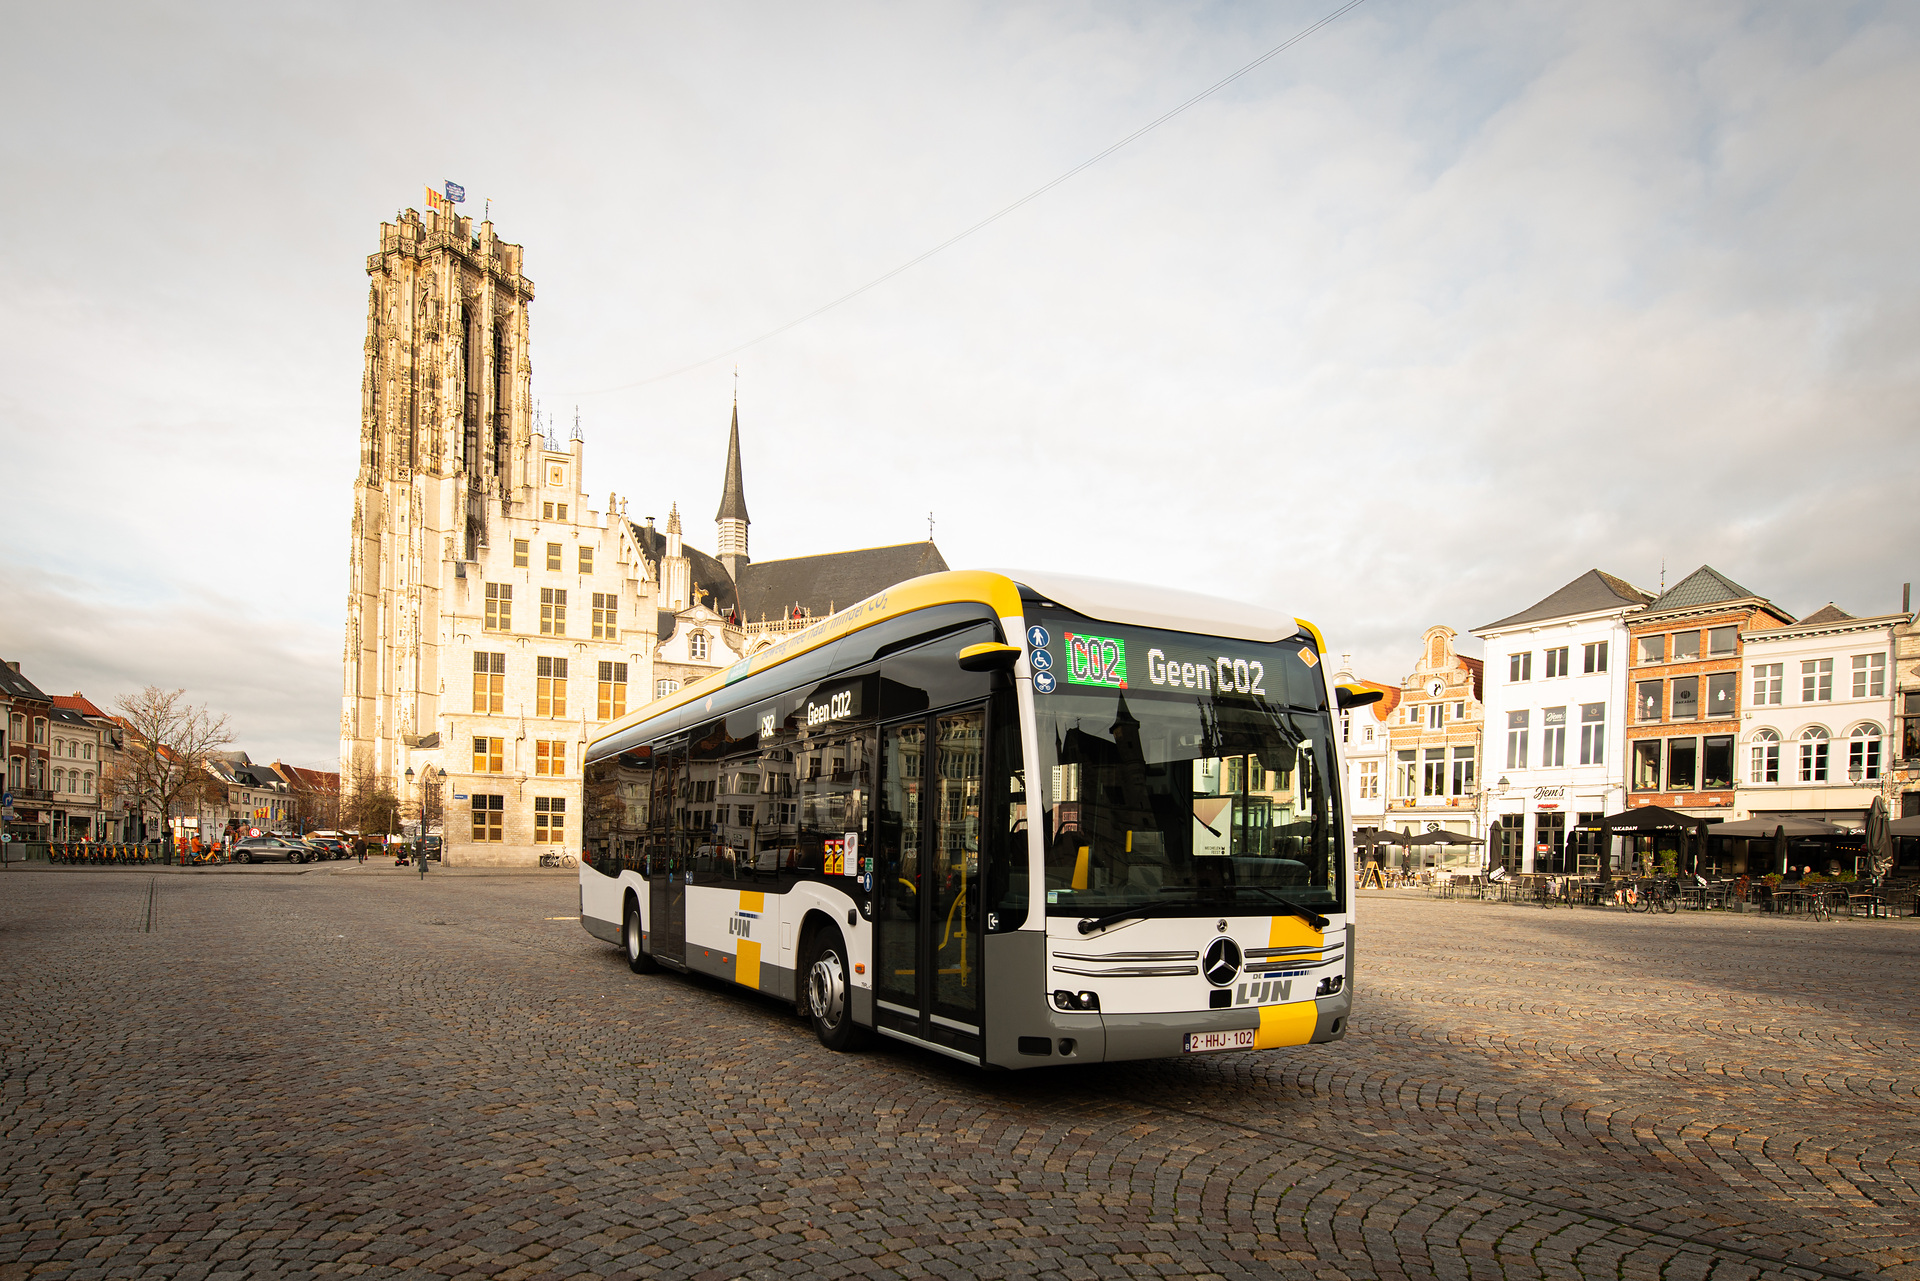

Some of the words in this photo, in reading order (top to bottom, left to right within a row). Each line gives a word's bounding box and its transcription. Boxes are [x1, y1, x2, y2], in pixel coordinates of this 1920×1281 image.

[1070, 635, 1121, 684] CO2
[1147, 648, 1211, 690] Geen
[1215, 656, 1266, 696] CO2
[807, 702, 830, 726] Geen
[831, 690, 851, 720] CO2
[1235, 979, 1292, 1005] LIJN
